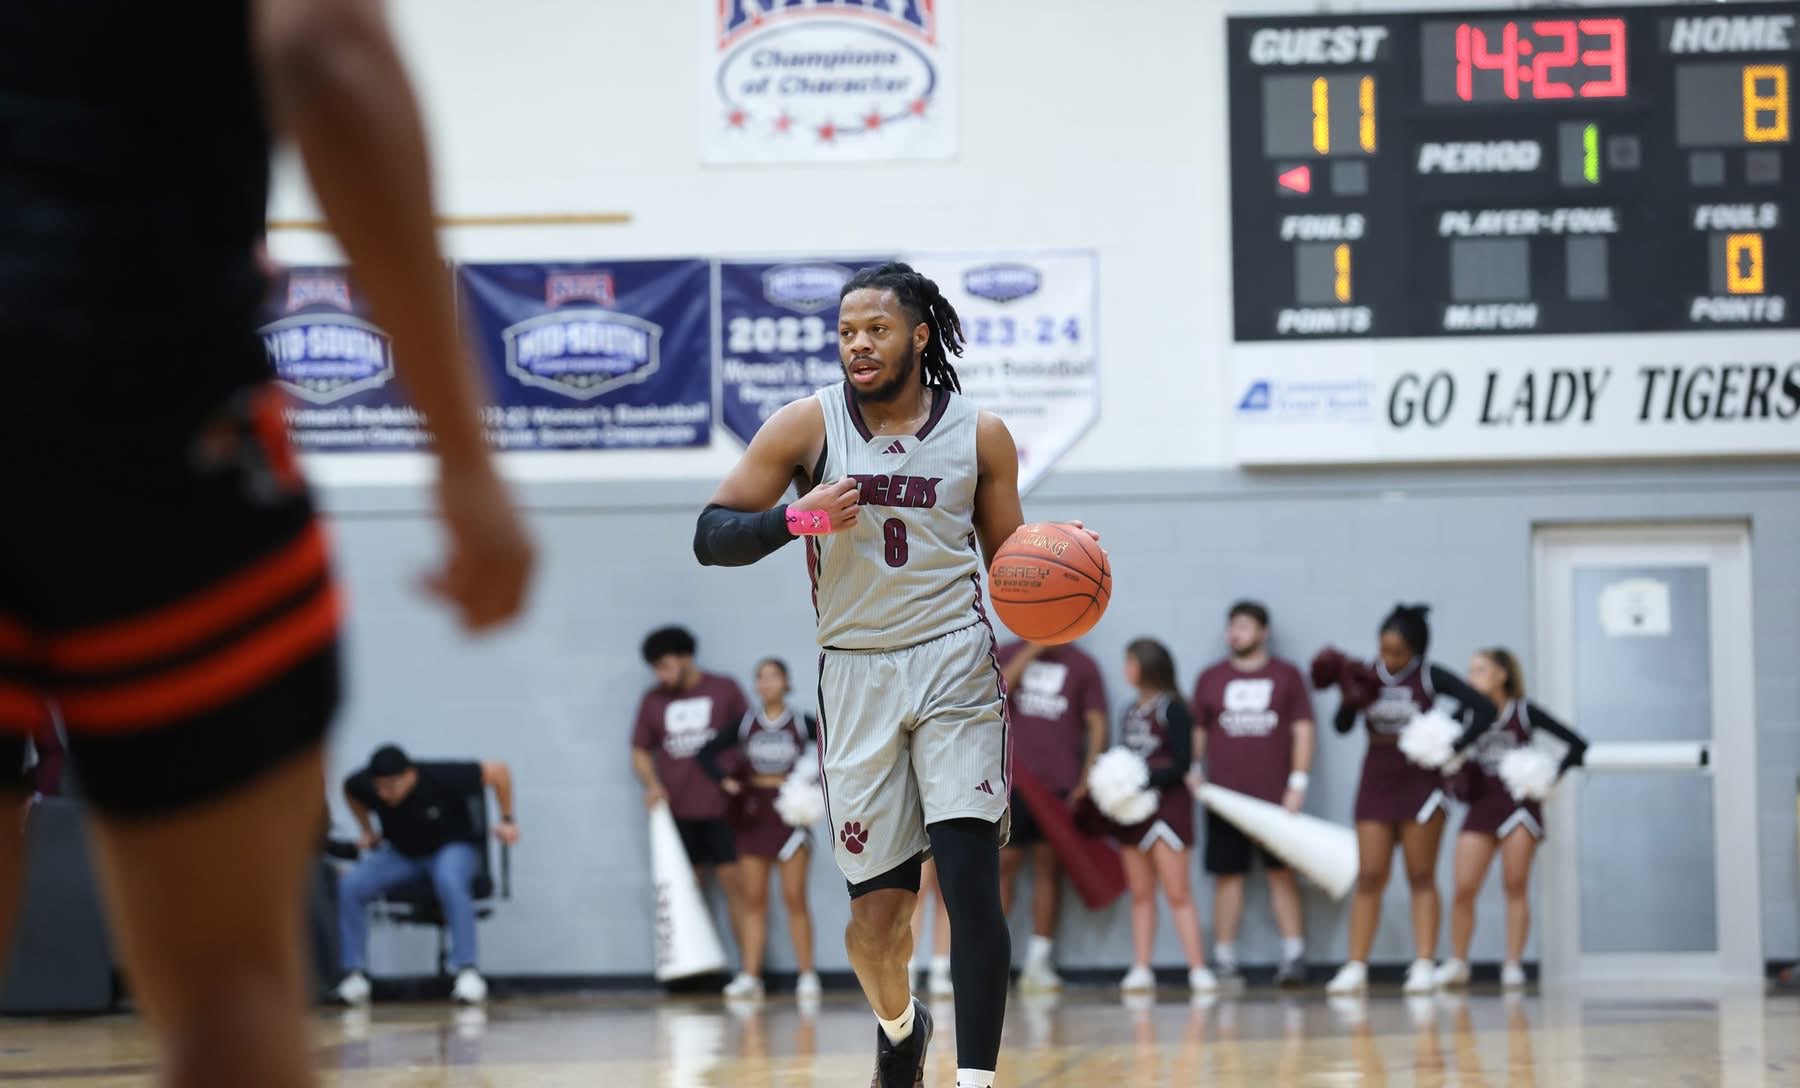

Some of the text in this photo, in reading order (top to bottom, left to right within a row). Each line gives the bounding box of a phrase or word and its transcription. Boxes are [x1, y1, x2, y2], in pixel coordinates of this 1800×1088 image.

[1249, 26, 1388, 65] GUEST
[1669, 15, 1795, 53] HOME
[1455, 18, 1627, 101] 14:23
[1312, 75, 1376, 154] 11
[1743, 64, 1790, 142] 8
[1418, 140, 1541, 173] PERIOD
[1583, 123, 1599, 184] 1
[1280, 213, 1365, 241] FOULS
[1439, 208, 1617, 237] PLAYER-FOUL
[1694, 202, 1778, 231] FOULS
[1334, 243, 1351, 303] 1
[1726, 233, 1764, 294] 0
[1277, 306, 1372, 334] POINTS
[1443, 302, 1538, 330] MATCH
[1690, 296, 1785, 322] POINTS
[1388, 361, 1800, 428] GO LADY TIGERS
[848, 474, 943, 509] TIGERS
[884, 518, 908, 568] 8
